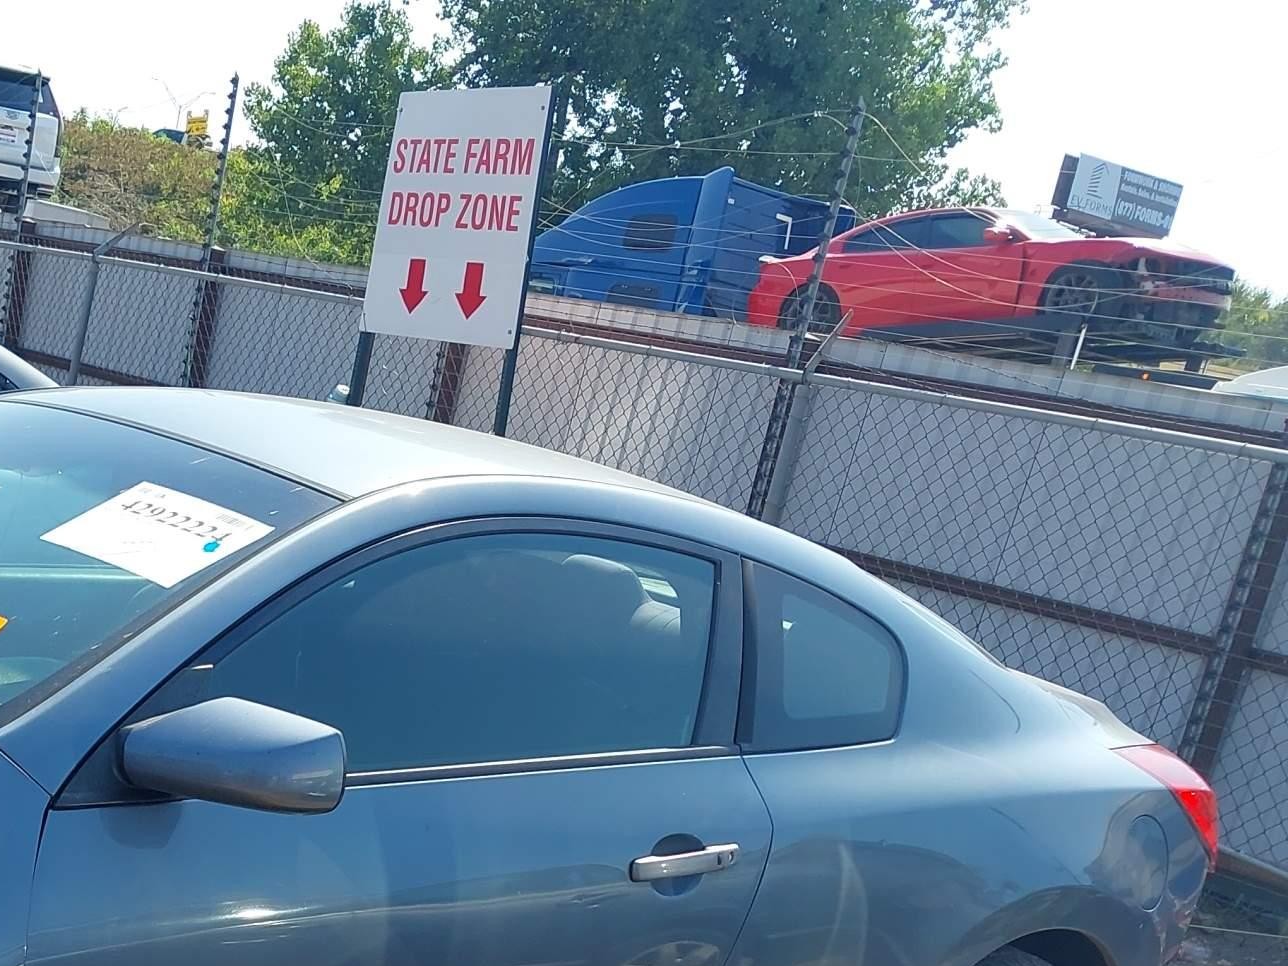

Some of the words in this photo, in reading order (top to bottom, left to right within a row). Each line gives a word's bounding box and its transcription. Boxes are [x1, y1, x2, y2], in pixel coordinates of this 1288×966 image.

[392, 138, 459, 175] STATE
[463, 138, 536, 176] FARM
[387, 191, 452, 228] DROP
[455, 193, 523, 232] ZONE
